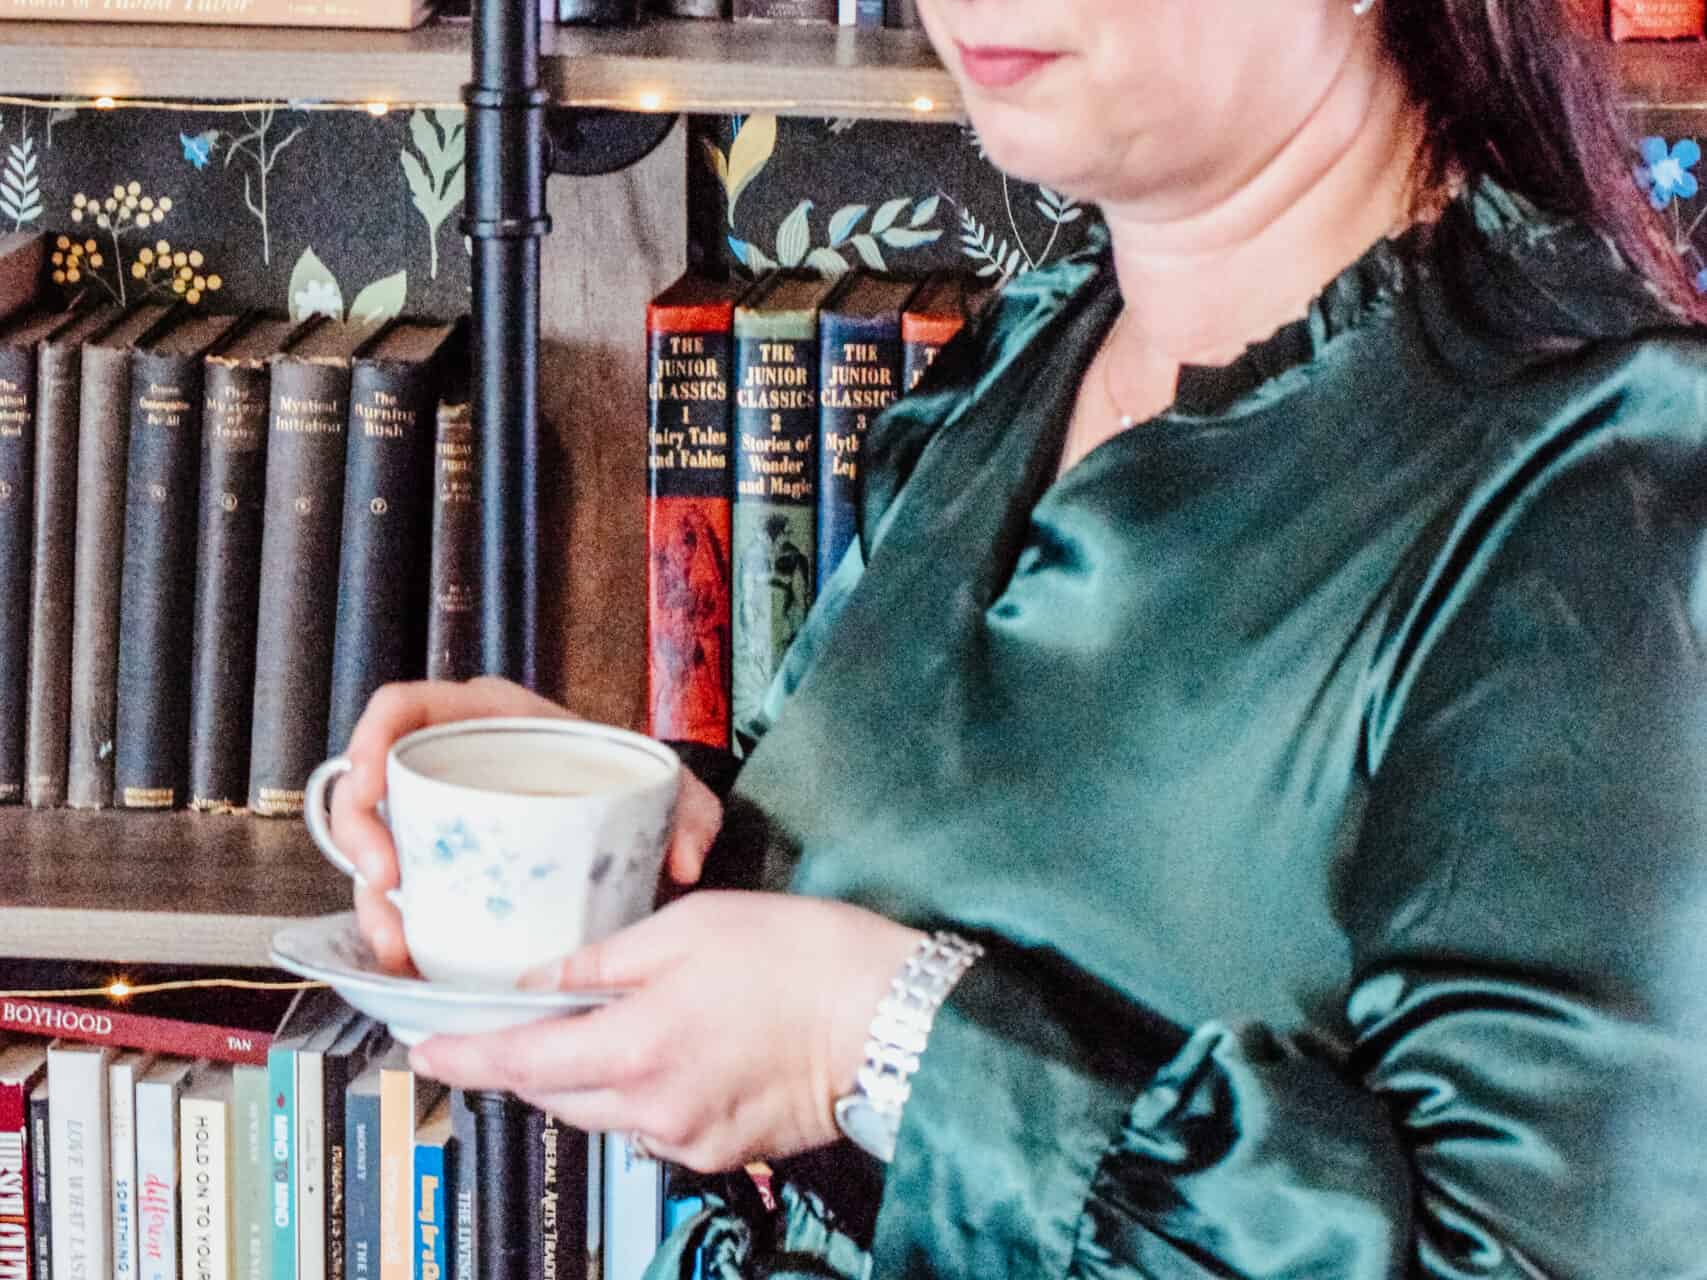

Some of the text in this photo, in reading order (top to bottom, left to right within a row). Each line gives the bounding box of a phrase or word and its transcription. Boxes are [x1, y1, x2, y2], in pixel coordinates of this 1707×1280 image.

[670, 336, 704, 354] THE
[760, 344, 794, 362] THE
[843, 343, 878, 362] THE
[655, 358, 718, 379] JUNIOR
[745, 366, 807, 386] JUNIOR
[829, 365, 892, 385] JUNIOR
[375, 391, 397, 405] The
[648, 382, 727, 400] CLASSICS
[737, 389, 815, 408] CLASSICS
[280, 396, 337, 413] Mystical
[276, 416, 341, 433] Initiation
[682, 406, 689, 424] 1
[771, 413, 782, 432] 2
[857, 413, 867, 430] 3
[688, 426, 727, 445] Tales
[742, 434, 812, 453] Stories of
[680, 450, 726, 469] Fables
[748, 454, 804, 474] Wonder
[738, 477, 813, 499] and Magic
[3, 1002, 253, 1052] BOYHOOD TAN
[194, 1115, 209, 1166] HOLD
[195, 1171, 210, 1199] ON
[540, 1128, 560, 1229] LIBERAL ARTS
[67, 1175, 86, 1232] WHAT
[457, 1190, 471, 1227] THE
[115, 1178, 129, 1273] SOMETHING
[137, 1173, 171, 1261] different
[196, 1205, 210, 1228] TO
[356, 1239, 368, 1272] THE
